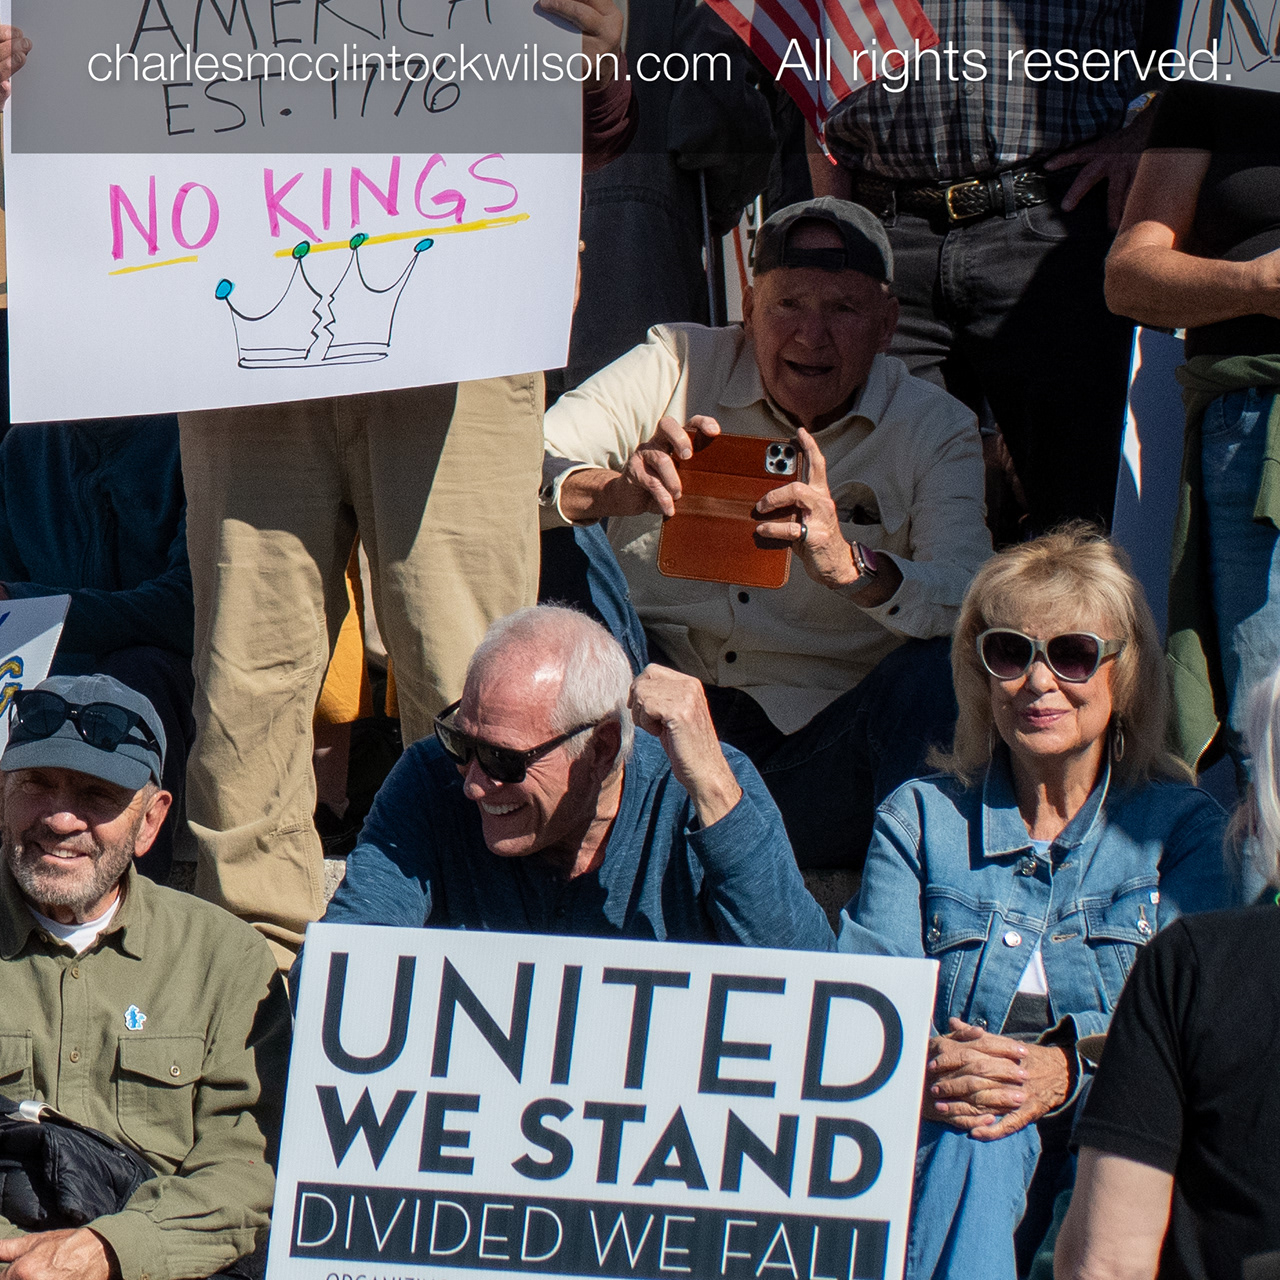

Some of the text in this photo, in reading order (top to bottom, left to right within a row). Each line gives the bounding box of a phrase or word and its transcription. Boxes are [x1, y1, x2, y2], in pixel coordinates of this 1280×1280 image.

[163, 59, 462, 137] EST. 1776
[107, 152, 520, 261] NO KINGS
[321, 950, 906, 1104] UNITED
[315, 1084, 884, 1201] WE STAND
[295, 1191, 565, 1263] DIVIDED
[589, 1208, 697, 1274] WE
